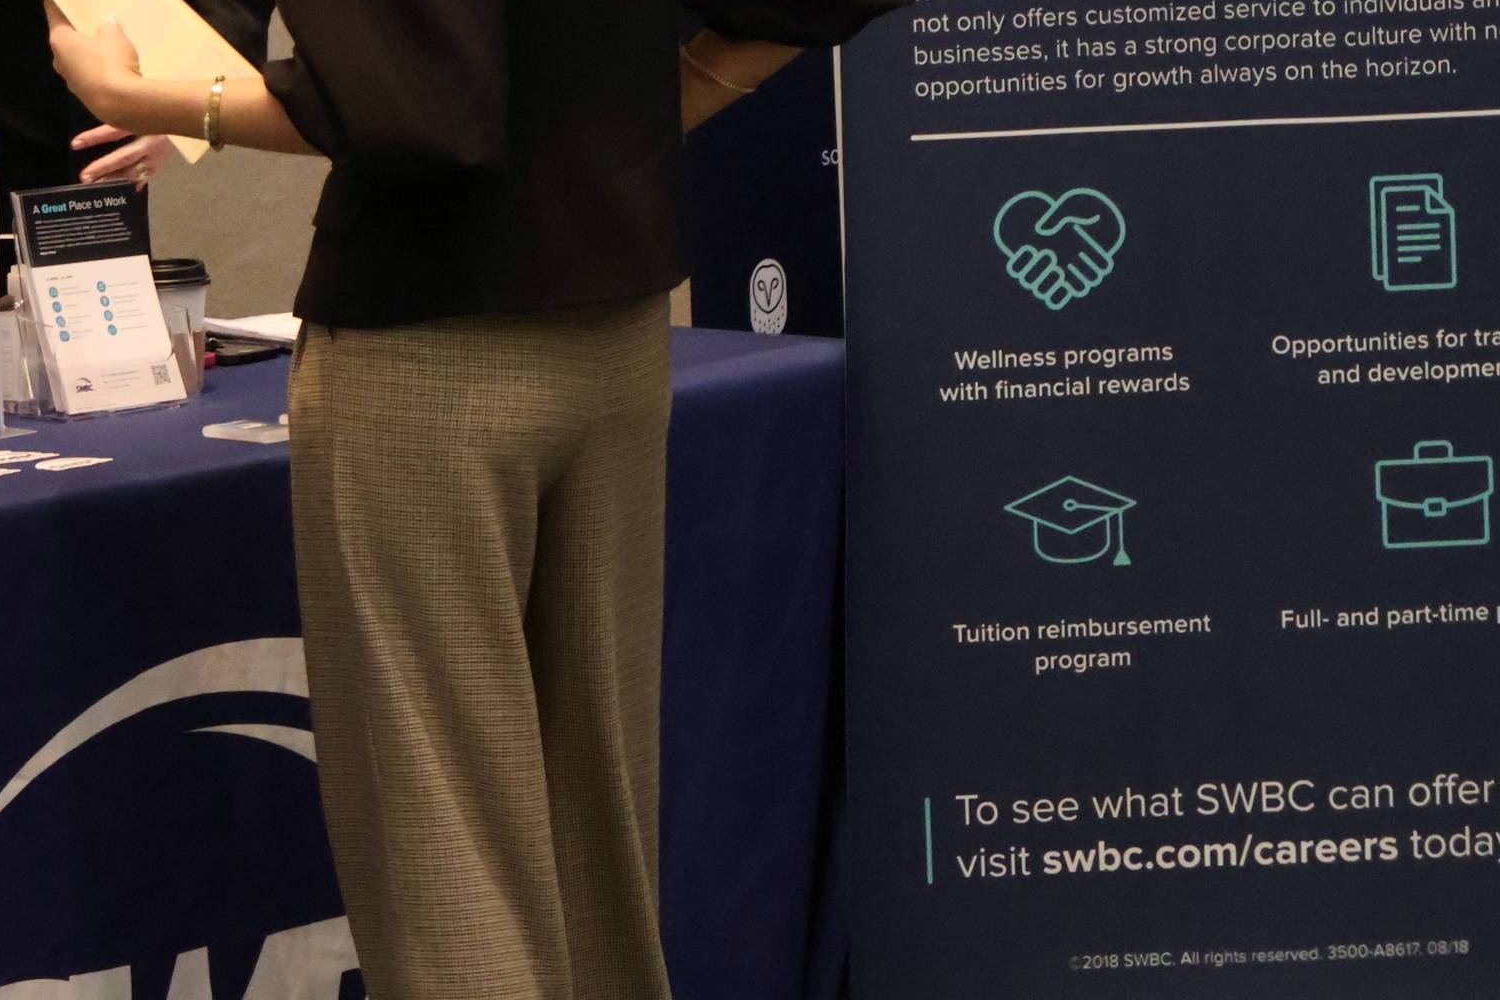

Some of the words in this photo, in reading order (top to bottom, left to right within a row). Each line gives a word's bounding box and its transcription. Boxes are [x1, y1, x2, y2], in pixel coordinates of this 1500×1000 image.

[913, 14, 949, 33] not
[957, 11, 1004, 34] only
[1012, 8, 1077, 29] offers
[1085, 1, 1216, 25] customized
[914, 44, 1048, 65] businesses,
[1056, 40, 1069, 58] it
[1078, 38, 1116, 57] has
[1124, 40, 1137, 56] a
[1144, 35, 1217, 56] strong
[1225, 30, 1336, 53] corporate
[1344, 26, 1421, 47] culture
[1430, 22, 1476, 42] with
[915, 72, 1067, 100] opportunities
[1075, 70, 1103, 89] for
[1113, 66, 1192, 92] growth
[1200, 64, 1277, 87] always
[1284, 64, 1312, 81] on
[1321, 60, 1358, 79] the
[1366, 57, 1456, 78] horizon.
[33, 205, 40, 215] A
[41, 203, 67, 214] Great
[69, 200, 91, 210] Place
[94, 199, 102, 208] to
[104, 196, 126, 206] Work
[955, 349, 1056, 370] Wellness
[1065, 345, 1173, 370] programs
[1272, 331, 1429, 358] Opportunities
[1436, 329, 1467, 349] for
[939, 381, 988, 402] with
[995, 377, 1091, 400] financial
[1098, 373, 1190, 396] rewards
[1318, 364, 1360, 384] and
[953, 623, 1030, 643] Tuition
[1038, 614, 1211, 640] reimbursement
[1281, 608, 1329, 629] Full-
[1337, 605, 1378, 627] and
[1387, 602, 1489, 629] part-time
[1035, 649, 1131, 675] program
[956, 795, 998, 826] To
[1013, 795, 1079, 825] see
[1092, 787, 1185, 820] what
[1197, 780, 1315, 816] SWBC
[1328, 783, 1395, 811] can
[1409, 773, 1495, 807] offer
[956, 844, 1030, 878] visit
[1043, 832, 1398, 876] swbc.com/careers
[1410, 826, 1500, 863] toda
[1181, 951, 1200, 965] All
[1204, 950, 1247, 968] rights
